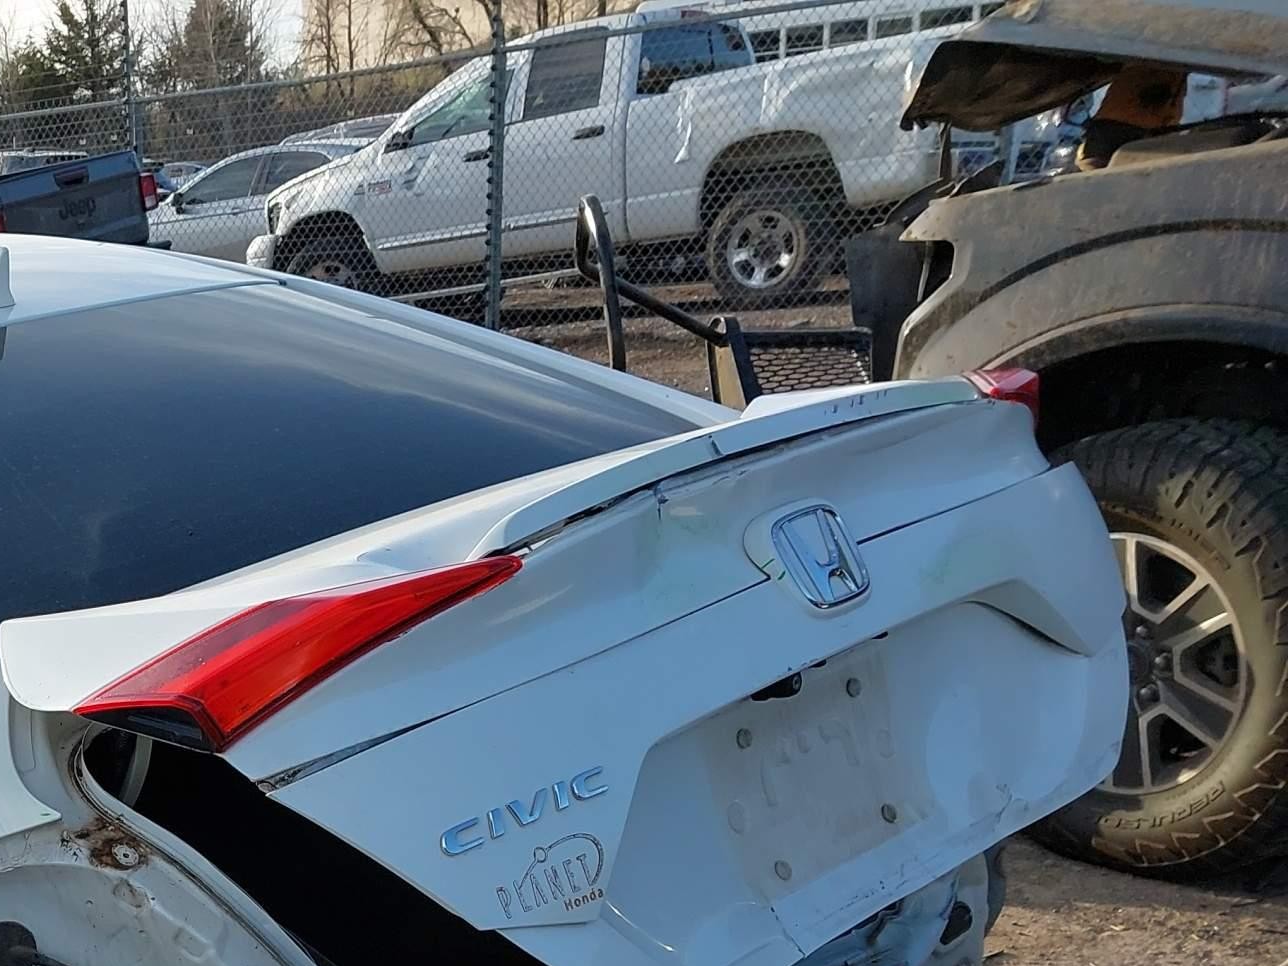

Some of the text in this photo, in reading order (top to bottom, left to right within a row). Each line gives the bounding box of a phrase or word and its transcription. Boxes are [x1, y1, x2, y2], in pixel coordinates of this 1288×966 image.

[58, 197, 96, 220] Jeep
[440, 766, 609, 857] CIVIC
[495, 853, 593, 920] PLANET
[563, 888, 605, 912] Honda
